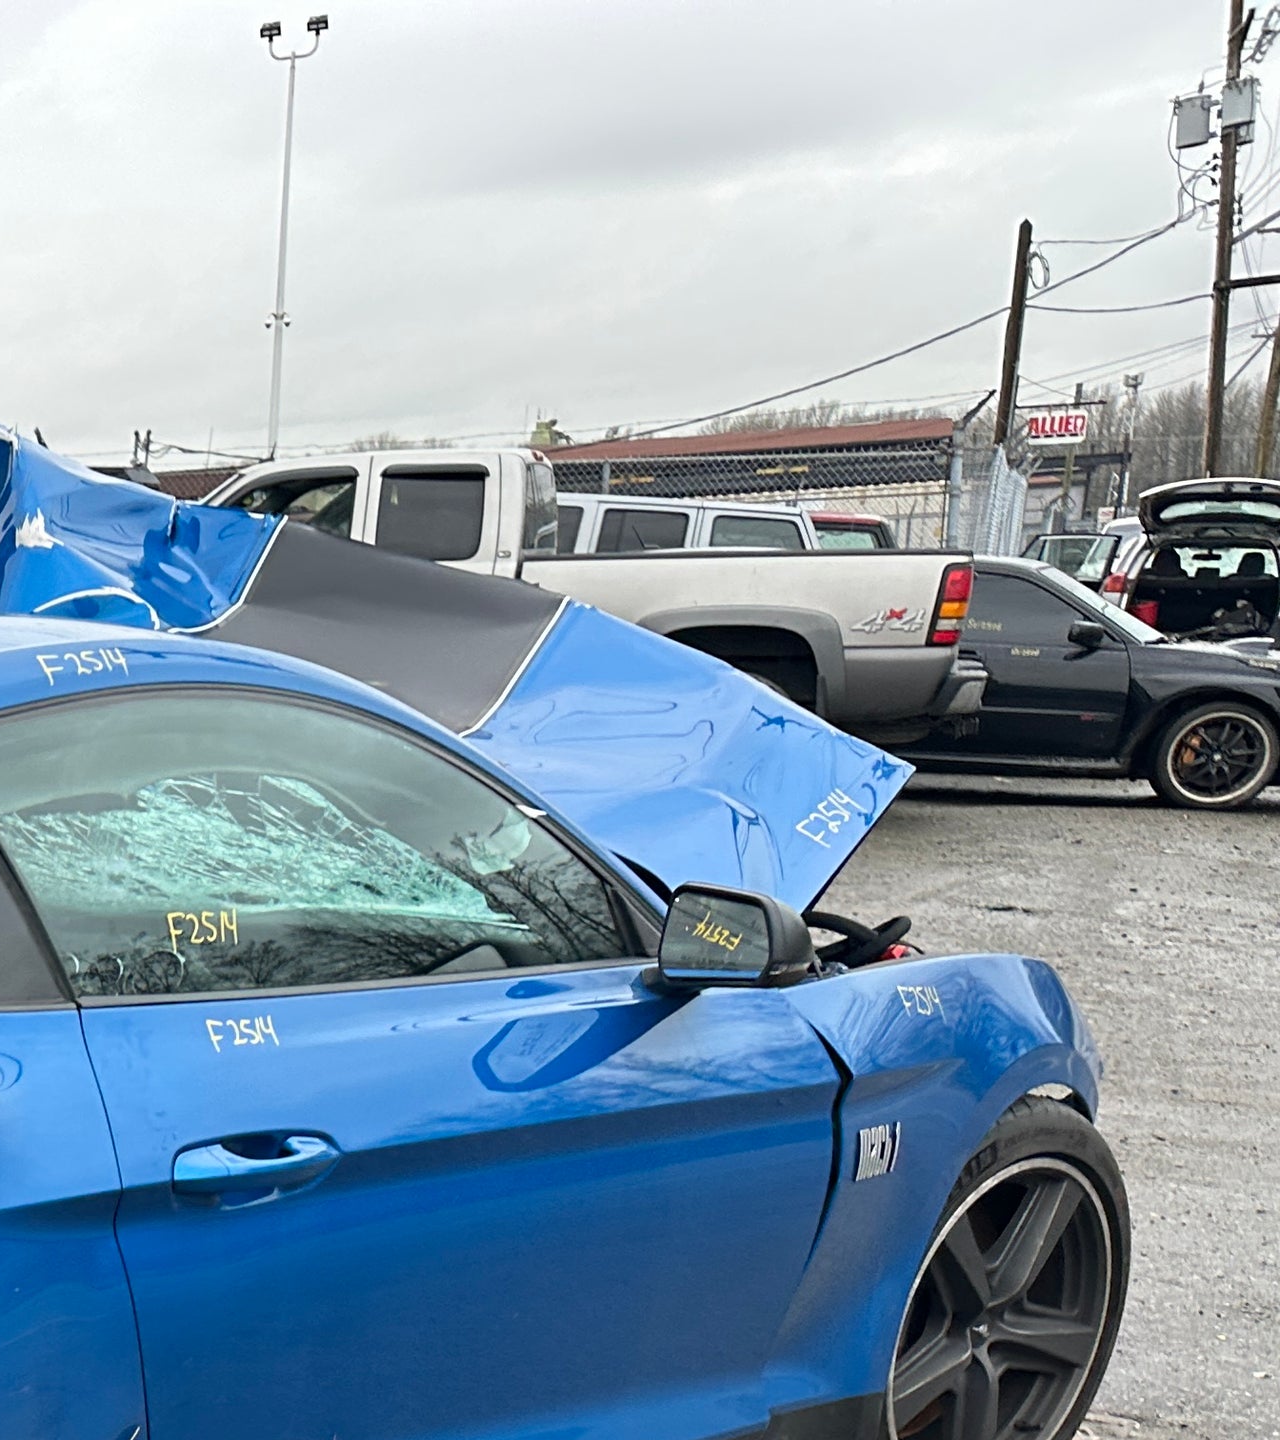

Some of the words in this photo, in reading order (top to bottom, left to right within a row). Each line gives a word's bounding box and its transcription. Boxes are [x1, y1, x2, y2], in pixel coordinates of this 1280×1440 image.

[1028, 413, 1087, 437] ALLIED
[36, 647, 129, 686] F2514
[795, 788, 868, 848] F2514
[166, 908, 238, 953] F2514
[692, 911, 743, 951] F2514
[205, 1014, 280, 1053] F2514
